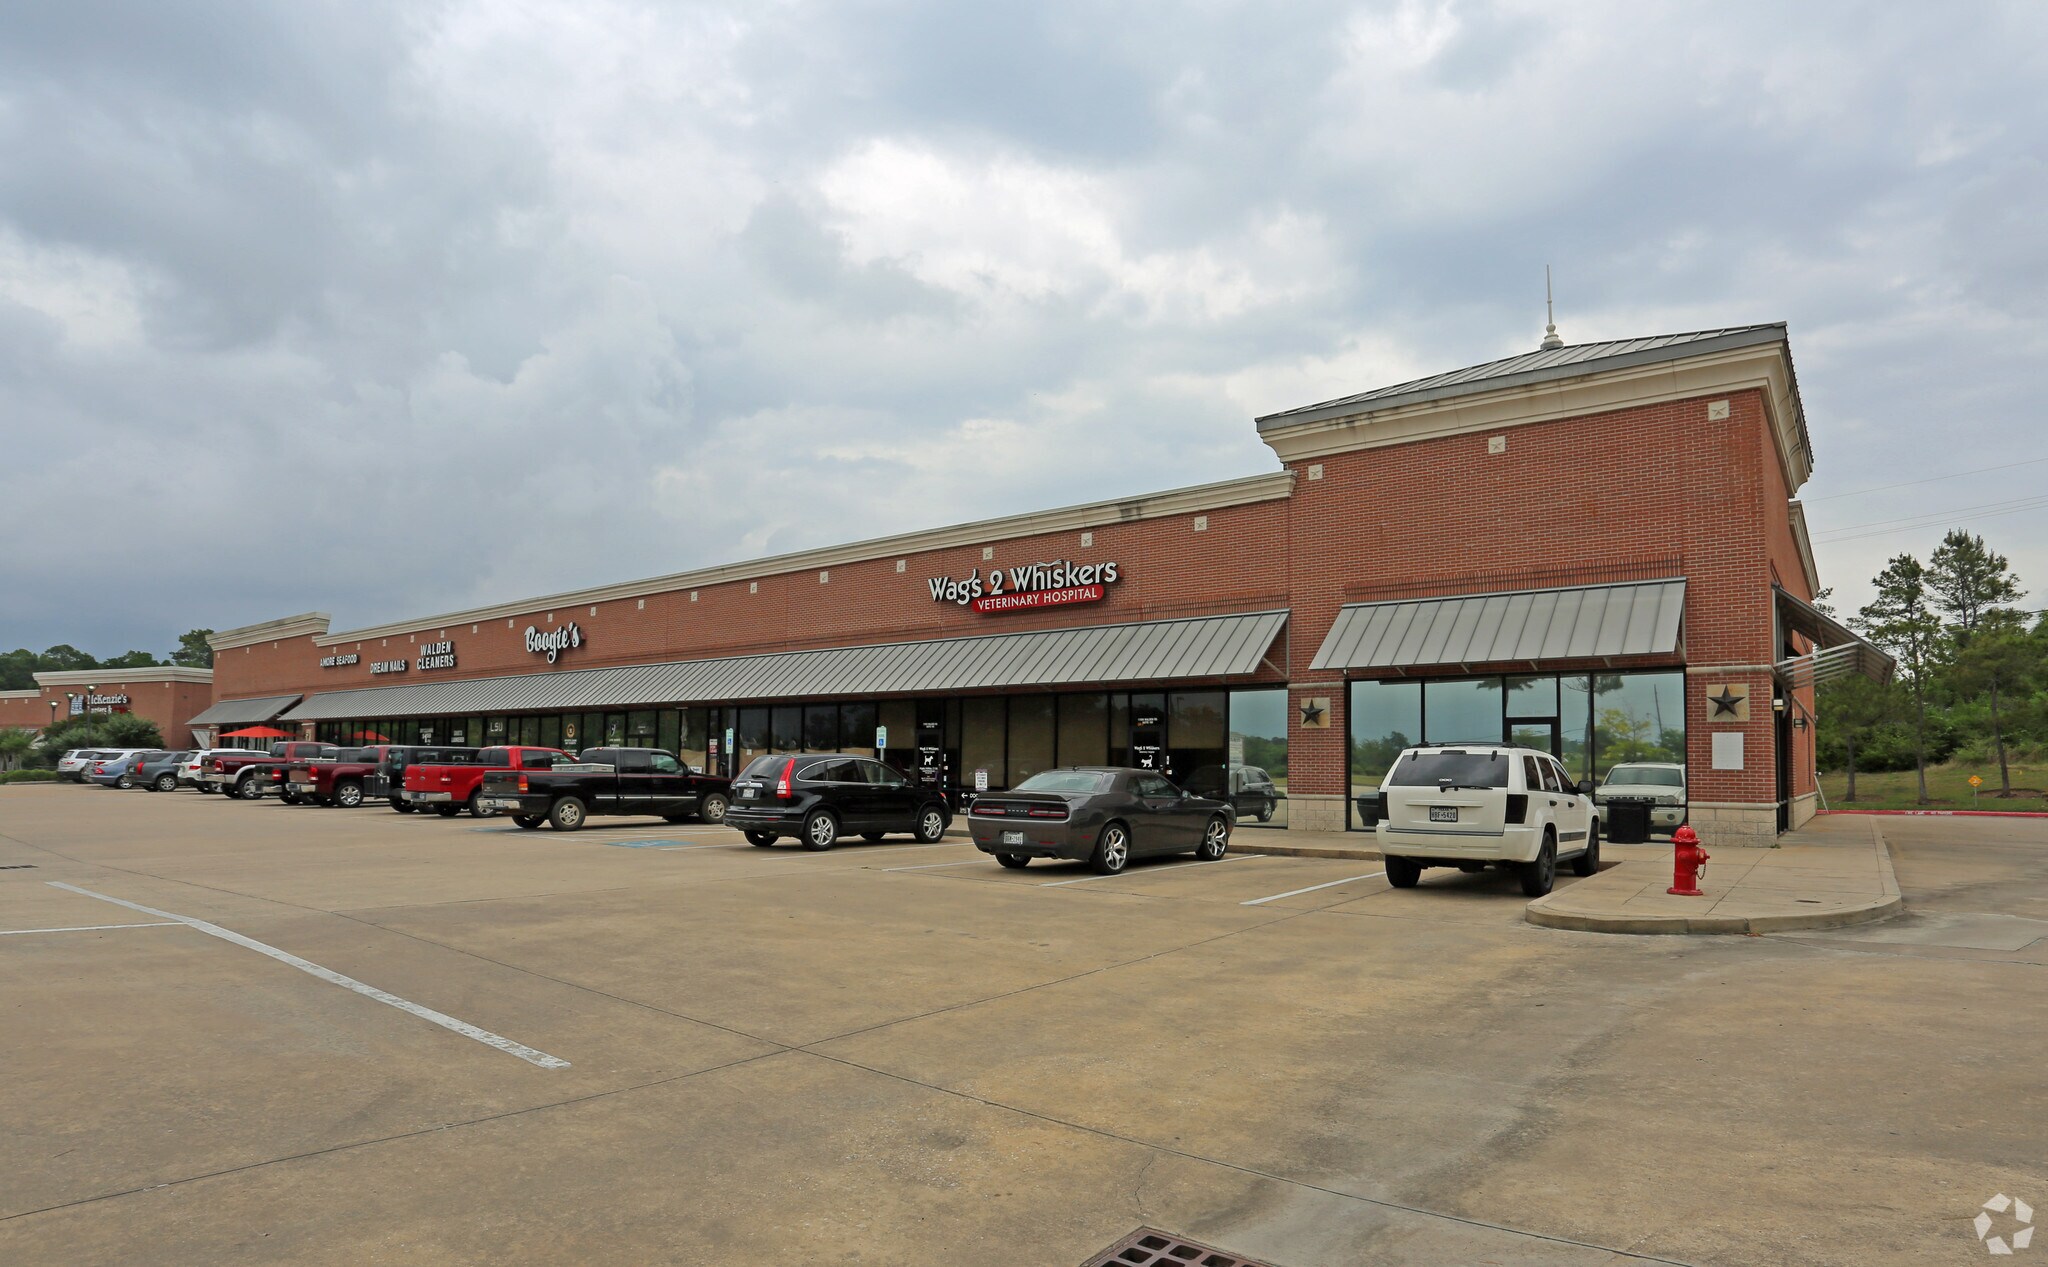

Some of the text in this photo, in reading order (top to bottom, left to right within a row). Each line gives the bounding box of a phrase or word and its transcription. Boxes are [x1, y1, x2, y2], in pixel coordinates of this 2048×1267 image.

[990, 570, 1003, 595] 2
[1010, 560, 1117, 592] Whiskers
[978, 587, 1097, 610] VETERINARY HOSPITAL
[420, 641, 451, 656] WALDEN
[524, 622, 579, 664] Boogie's
[320, 654, 357, 667] AMORE SEAFOOD
[370, 660, 406, 674] DREAM NAILS
[417, 655, 454, 670] CLEANERS
[490, 723, 503, 731] LSU
